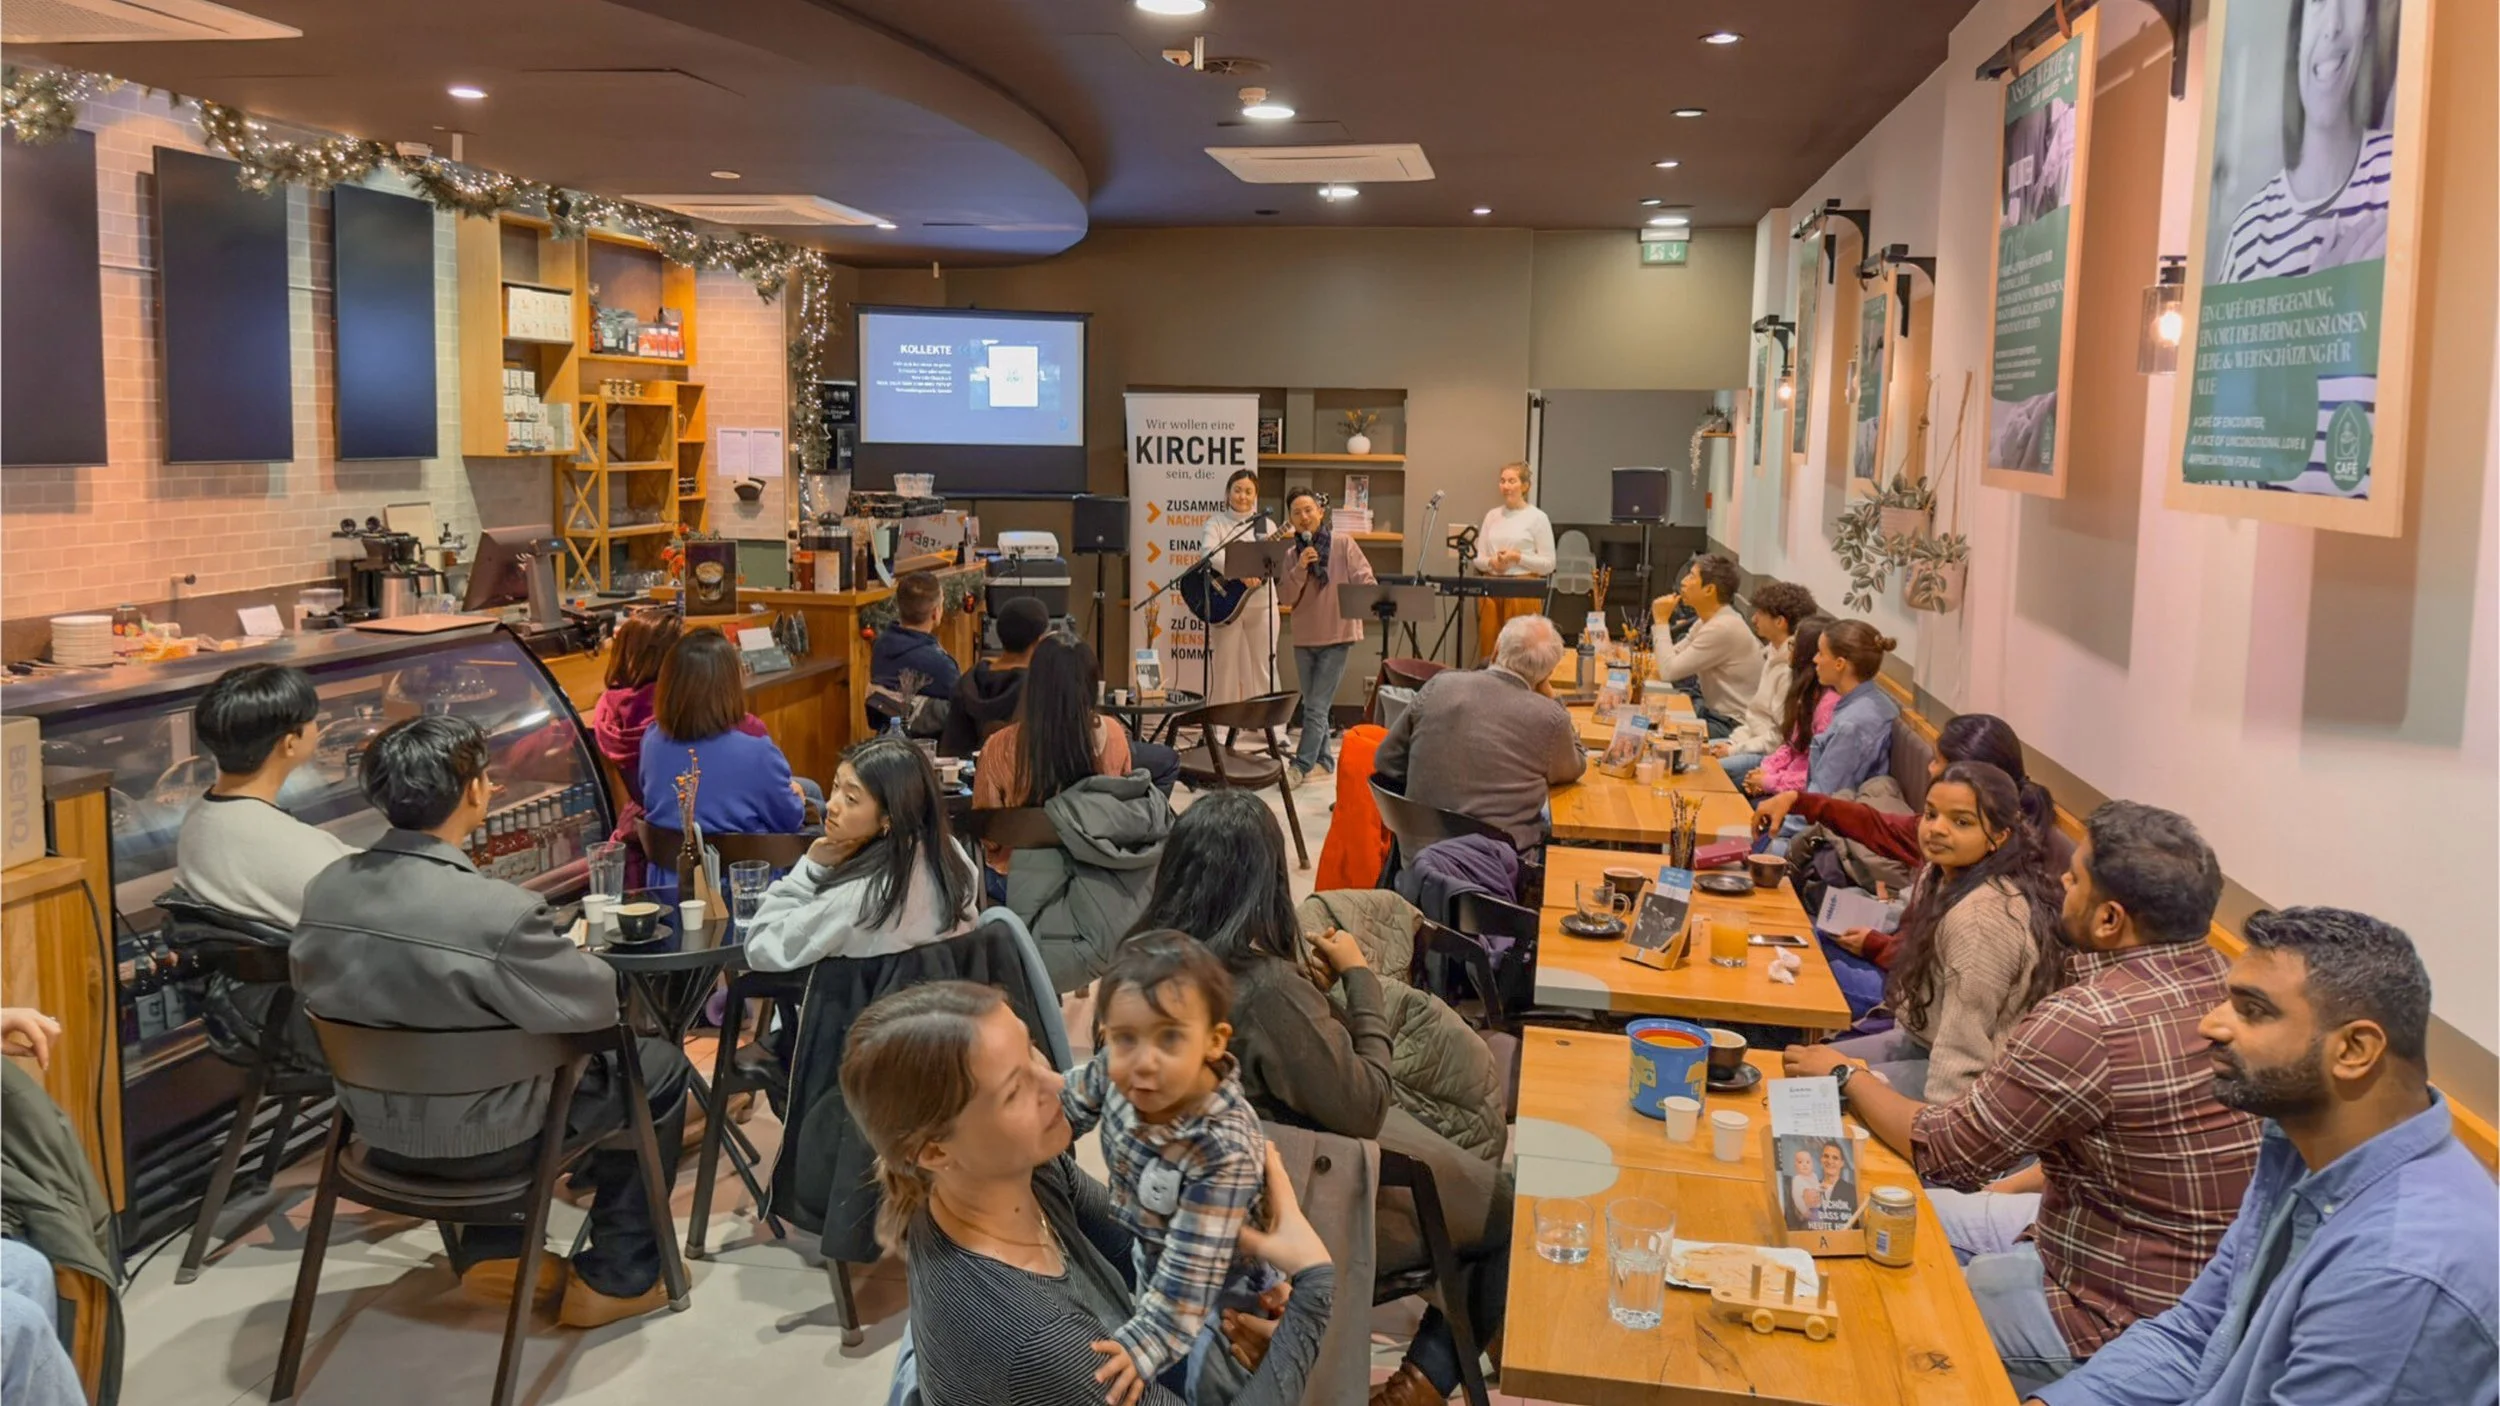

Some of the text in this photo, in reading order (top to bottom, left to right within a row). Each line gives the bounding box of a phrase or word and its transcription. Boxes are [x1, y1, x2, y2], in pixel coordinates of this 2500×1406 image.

[900, 344, 952, 355] KOLLEKTE
[2222, 352, 2234, 370] &
[2326, 337, 2351, 364] FÜR
[1146, 419, 1236, 431] Wir wollen eine
[1136, 435, 1246, 466] KIRCHE
[1166, 469, 1215, 480] sein, die:
[1166, 499, 1229, 512] ZUSAMME
[1170, 617, 1204, 631] ZU DE
[1819, 1235, 1829, 1249] A
